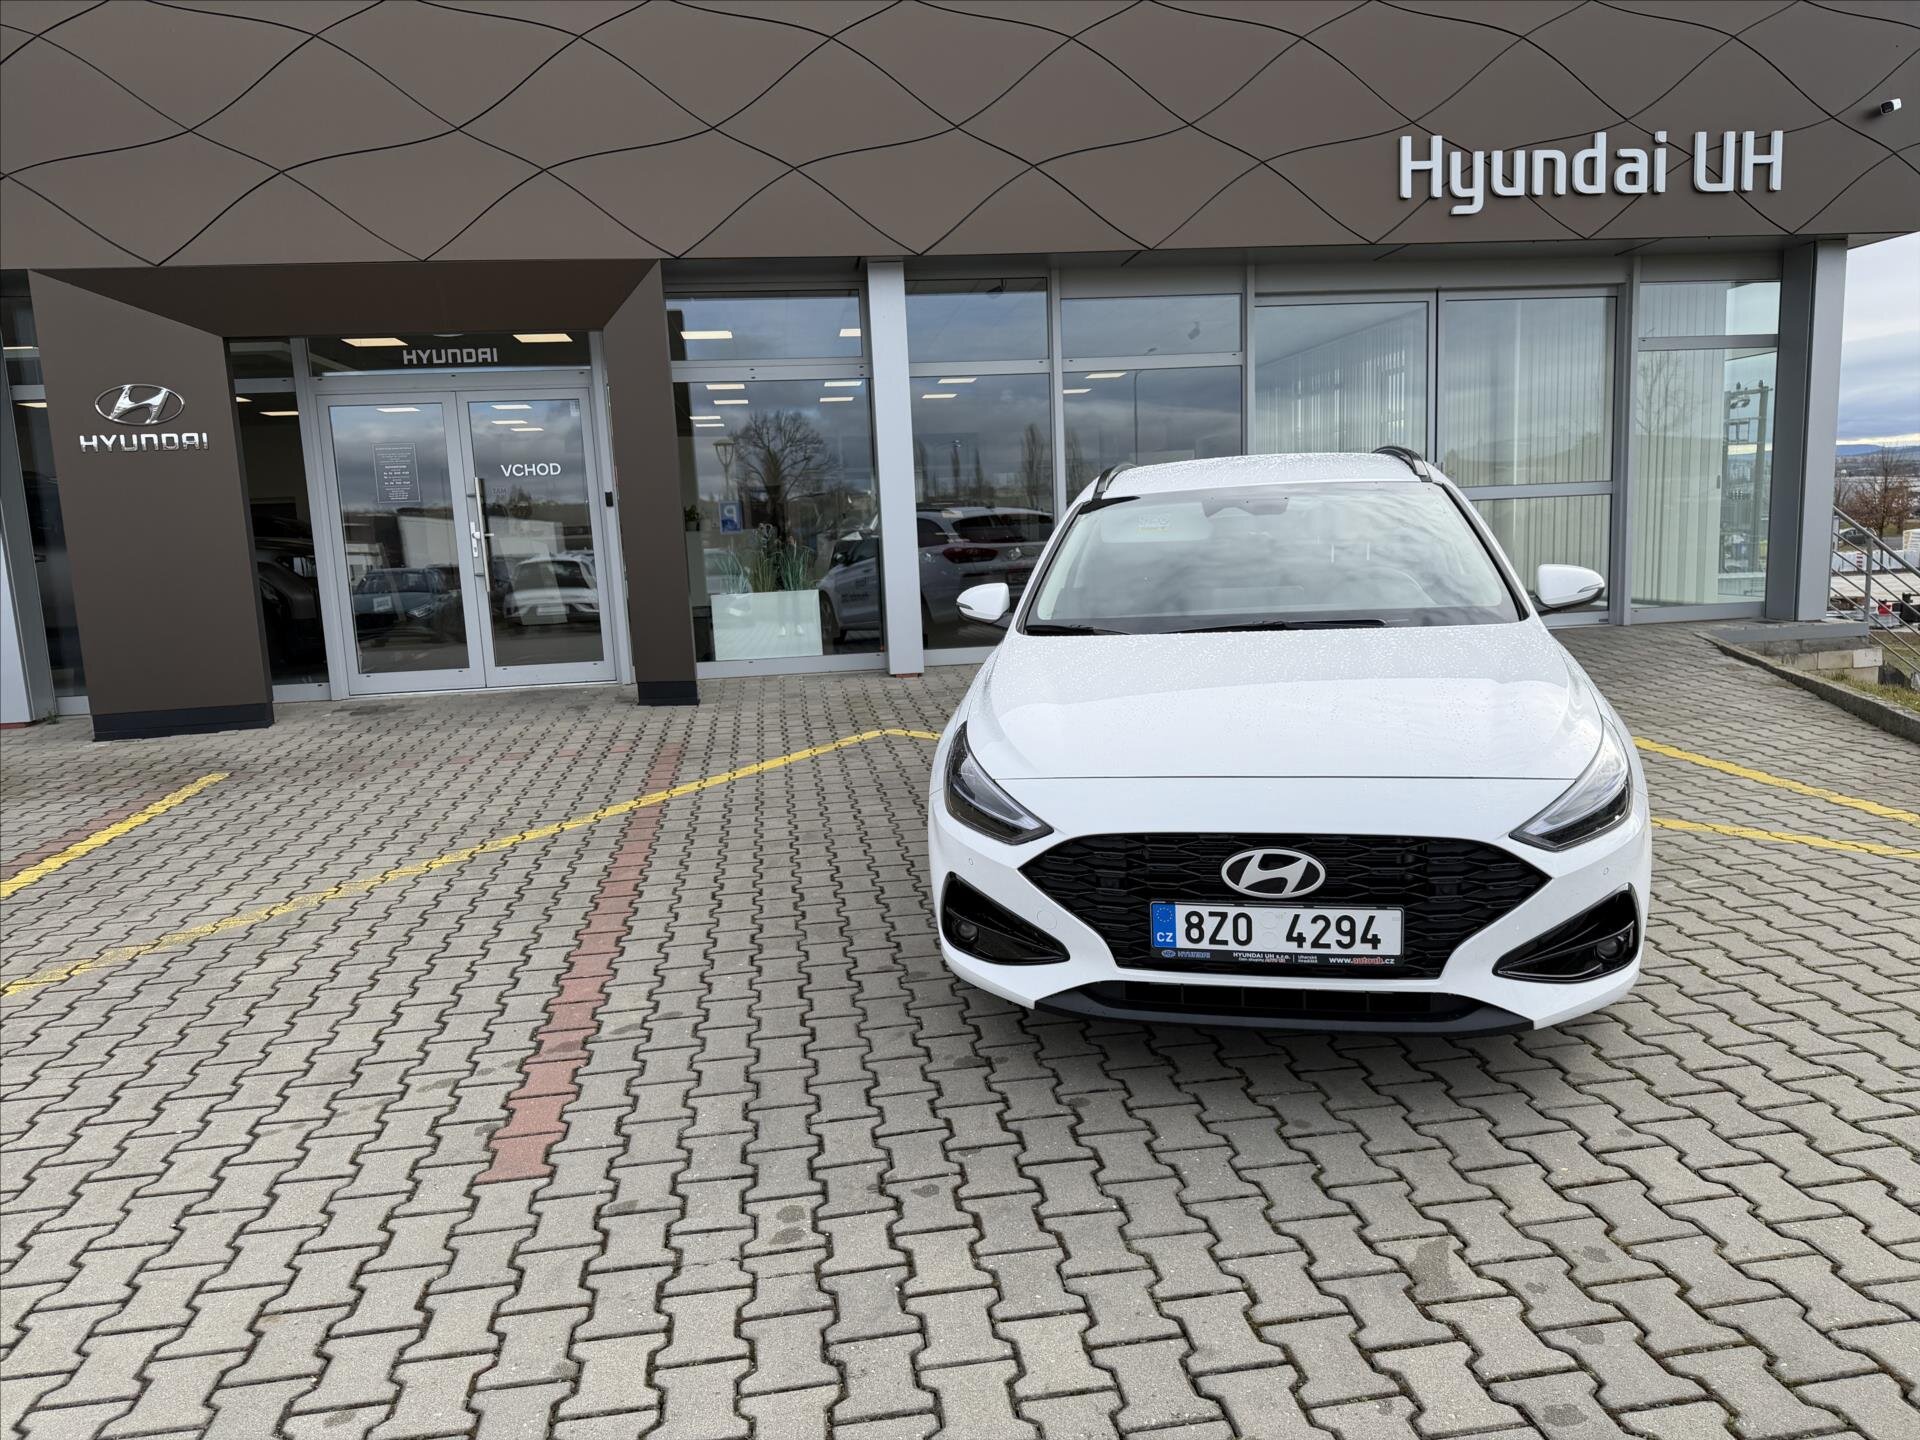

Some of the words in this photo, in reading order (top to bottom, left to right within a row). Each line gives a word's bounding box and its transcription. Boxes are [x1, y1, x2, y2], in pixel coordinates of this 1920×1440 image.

[1400, 130, 1667, 216] Hyundai
[1694, 130, 1783, 193] UH
[402, 347, 498, 365] HYUNDAI
[79, 432, 209, 453] HYUNDAI
[500, 463, 562, 477] VCHOD
[1156, 931, 1174, 943] CZ
[1285, 913, 1382, 950] 4294
